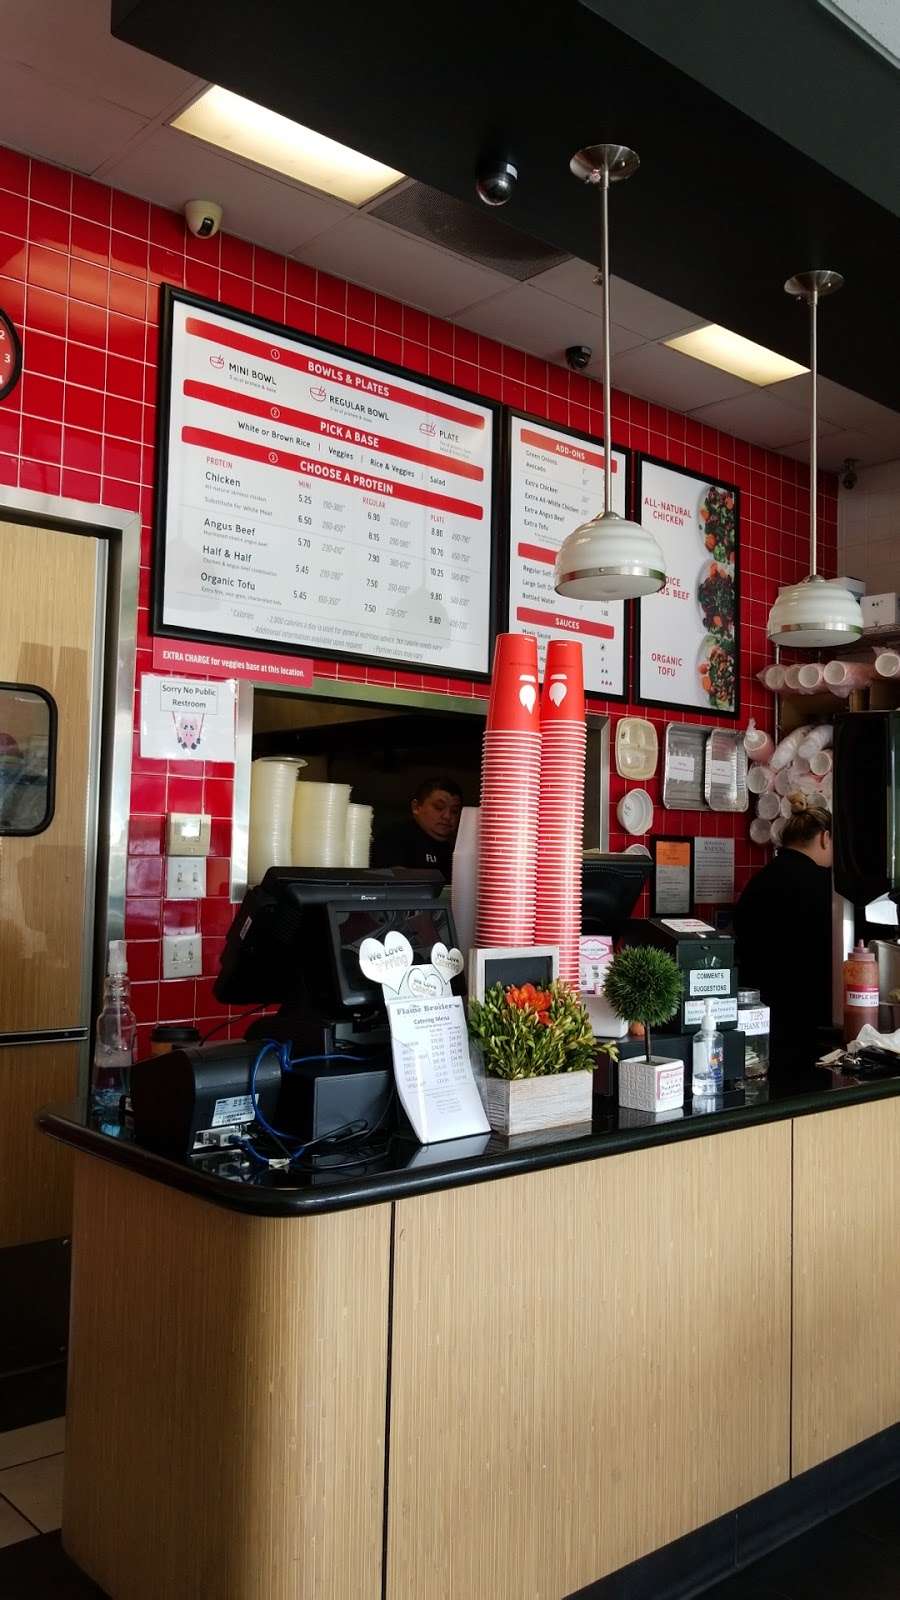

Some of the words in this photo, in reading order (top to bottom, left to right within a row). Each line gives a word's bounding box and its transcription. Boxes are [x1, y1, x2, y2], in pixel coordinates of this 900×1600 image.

[4, 353, 10, 363] 3
[229, 362, 249, 376] MINI
[252, 370, 277, 385] BOWL
[308, 361, 343, 382] BOWLS
[346, 375, 352, 384] &
[356, 377, 390, 396] PLATES
[329, 395, 365, 412] REGULAR
[367, 408, 389, 420] BOWL
[238, 421, 260, 434] White
[272, 430, 294, 444] Brown
[296, 437, 311, 447] Rice
[320, 422, 343, 437] PICK
[345, 430, 352, 440] A
[354, 432, 380, 448] BASE
[440, 430, 459, 443] PLATE
[329, 446, 354, 460] Veggies
[526, 450, 541, 460] Green
[556, 444, 585, 460] ADD-ONS
[206, 456, 232, 469] PROTEIN
[370, 458, 383, 468] Rice
[392, 464, 414, 478] Veggies
[526, 462, 546, 472] Avocado
[206, 472, 240, 487] Chicken
[300, 461, 342, 481] CHOOSE
[344, 473, 350, 482] A
[353, 476, 393, 494] PROTEIN
[430, 476, 446, 486] Salad
[298, 480, 311, 489] MINI
[526, 479, 538, 488] Extra
[540, 483, 558, 494] Chicken
[298, 494, 312, 504] 5.25
[362, 496, 385, 508] REGULAR
[525, 492, 538, 502] Extra
[562, 503, 579, 513] Chicken
[525, 506, 538, 515] Extra
[540, 510, 553, 520] Angus
[554, 513, 565, 522] Beef
[644, 498, 692, 519] ALL-NATURAL
[298, 515, 312, 525] 6.50
[653, 510, 684, 527] CHICKEN
[204, 518, 232, 531] Angus
[236, 524, 256, 536] Beef
[524, 519, 538, 528] Extra
[539, 522, 549, 531] Tofu
[298, 538, 310, 548] 5.70
[203, 545, 221, 556] Half
[224, 549, 230, 559] &
[234, 552, 252, 562] Half
[296, 564, 309, 574] 5.45
[430, 568, 444, 577] 10.25
[522, 565, 540, 575] Regular
[200, 572, 234, 587] Organic
[238, 579, 255, 590] Tofu
[522, 579, 536, 588] Large
[537, 582, 546, 590] Soft
[665, 576, 680, 587] OICE
[294, 590, 306, 600] 5.45
[522, 593, 540, 602] Bottled
[541, 596, 556, 604] Water
[673, 589, 690, 601] BEEF
[364, 604, 376, 613] 7.50
[555, 618, 580, 629] SAUCES
[163, 650, 184, 662] EXTRA
[185, 653, 210, 665] CHARGE
[211, 657, 220, 666] for
[222, 659, 245, 670] veggies
[246, 662, 259, 672] base
[268, 665, 279, 674] this
[651, 653, 682, 667] ORGANIC
[658, 666, 676, 677] TOFU
[162, 685, 182, 697] Sorry
[184, 686, 193, 695] No
[195, 687, 216, 696] Public
[172, 699, 206, 709] Restroom
[368, 953, 382, 962] We
[385, 946, 404, 957] Love
[424, 1003, 452, 1012] Broiler
